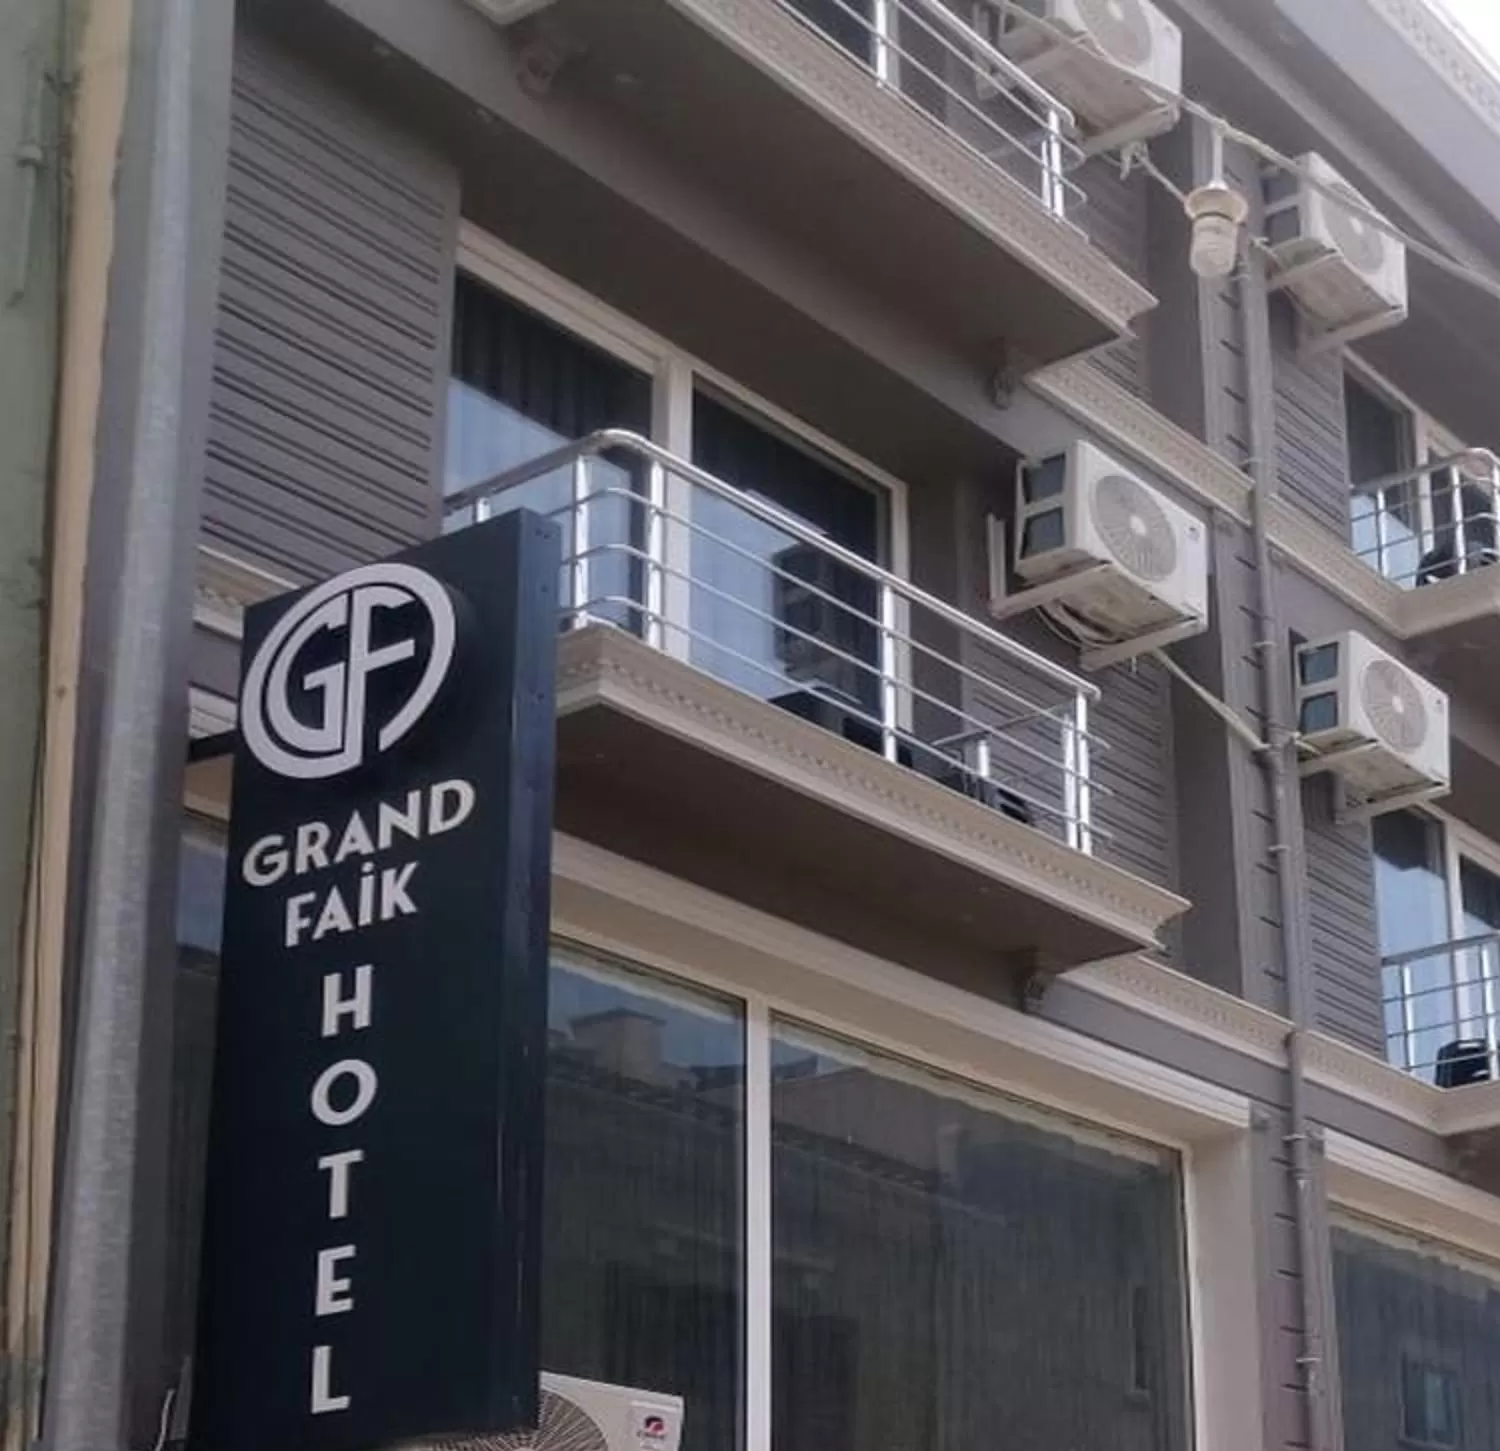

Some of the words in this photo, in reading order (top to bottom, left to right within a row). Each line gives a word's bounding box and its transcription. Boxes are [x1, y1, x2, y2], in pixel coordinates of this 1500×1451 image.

[243, 779, 475, 887] GRAND
[285, 861, 419, 948] FAİK
[311, 964, 378, 1414] HOTEL
